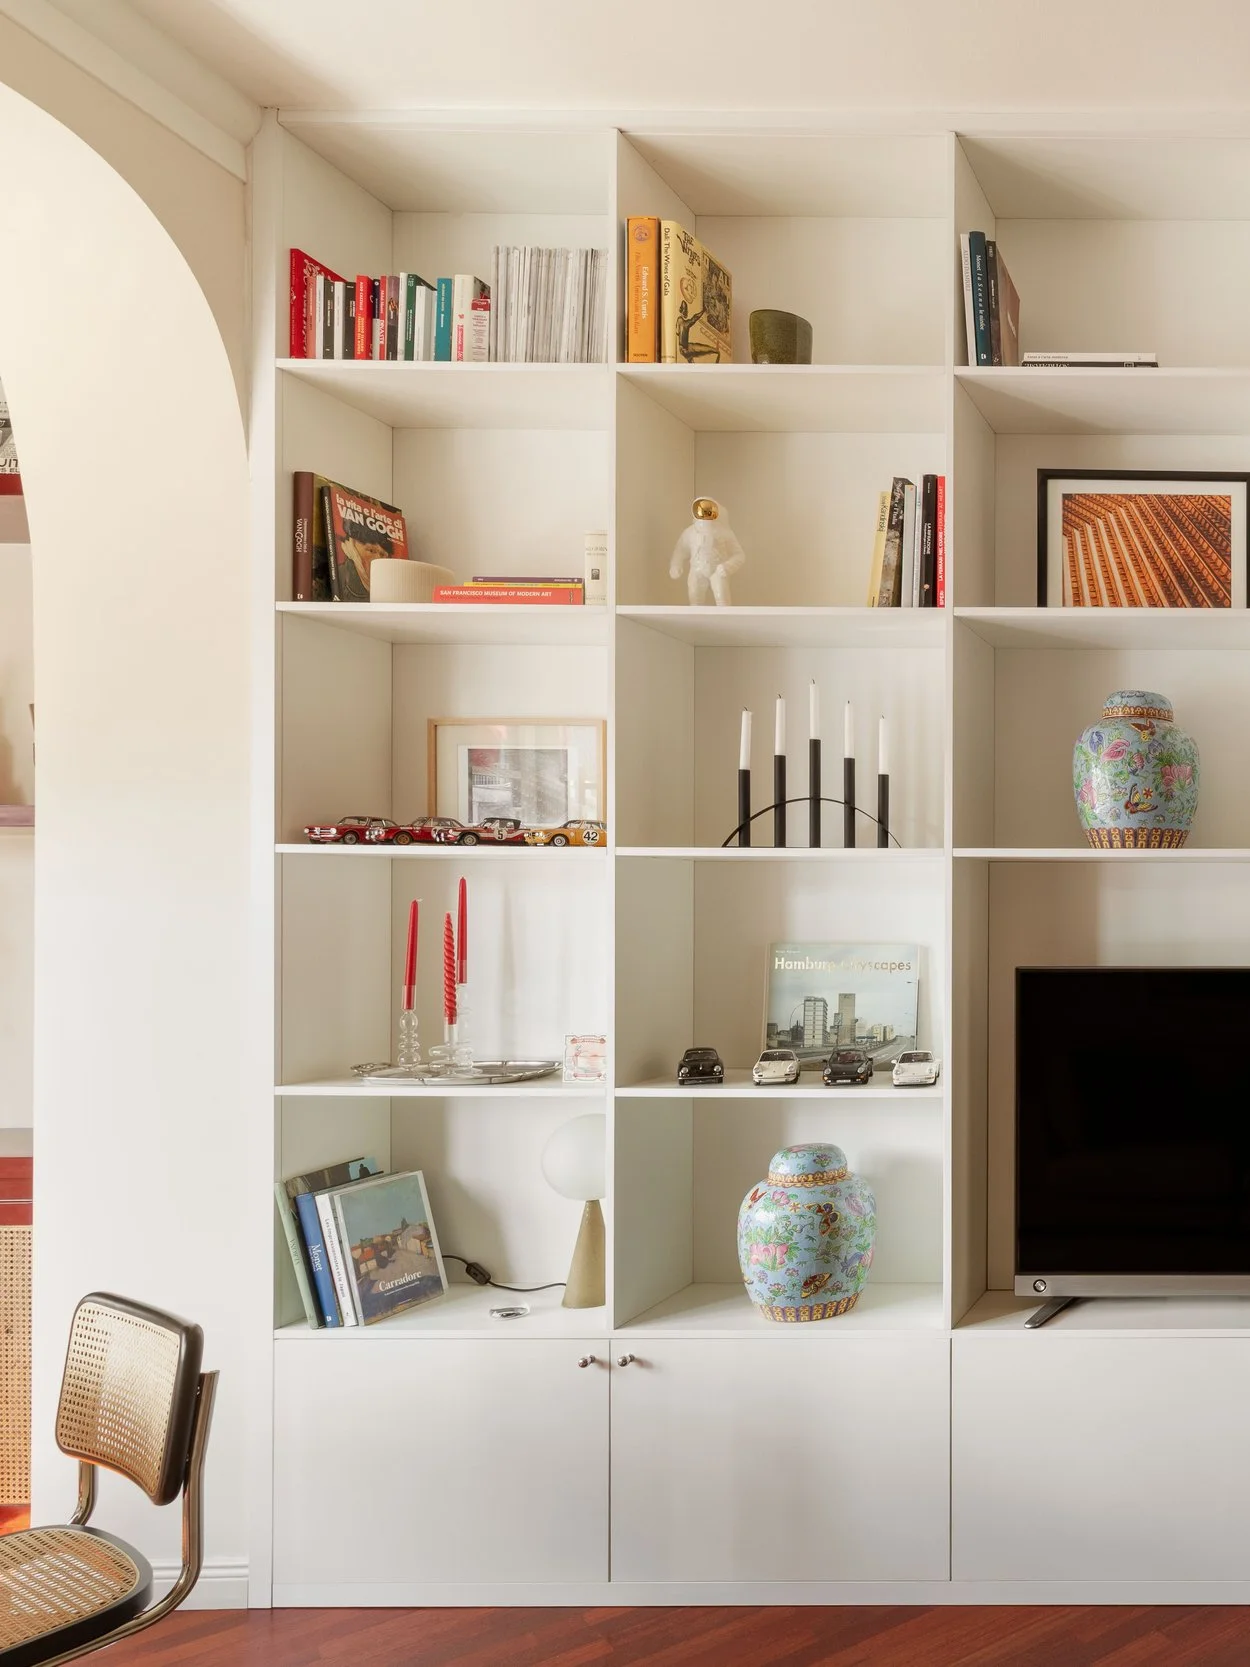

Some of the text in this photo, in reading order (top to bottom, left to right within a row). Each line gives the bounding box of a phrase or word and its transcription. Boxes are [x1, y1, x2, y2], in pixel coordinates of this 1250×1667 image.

[336, 493, 344, 505] la
[346, 500, 362, 512] vita
[371, 508, 392, 524] l'arte
[394, 520, 403, 529] di
[337, 504, 403, 541] VAN GOGH
[497, 830, 503, 840] 5
[583, 831, 597, 841] 42
[774, 956, 835, 972] Hamburg
[311, 1244, 323, 1271] Monet
[379, 1271, 422, 1291] Carradore
